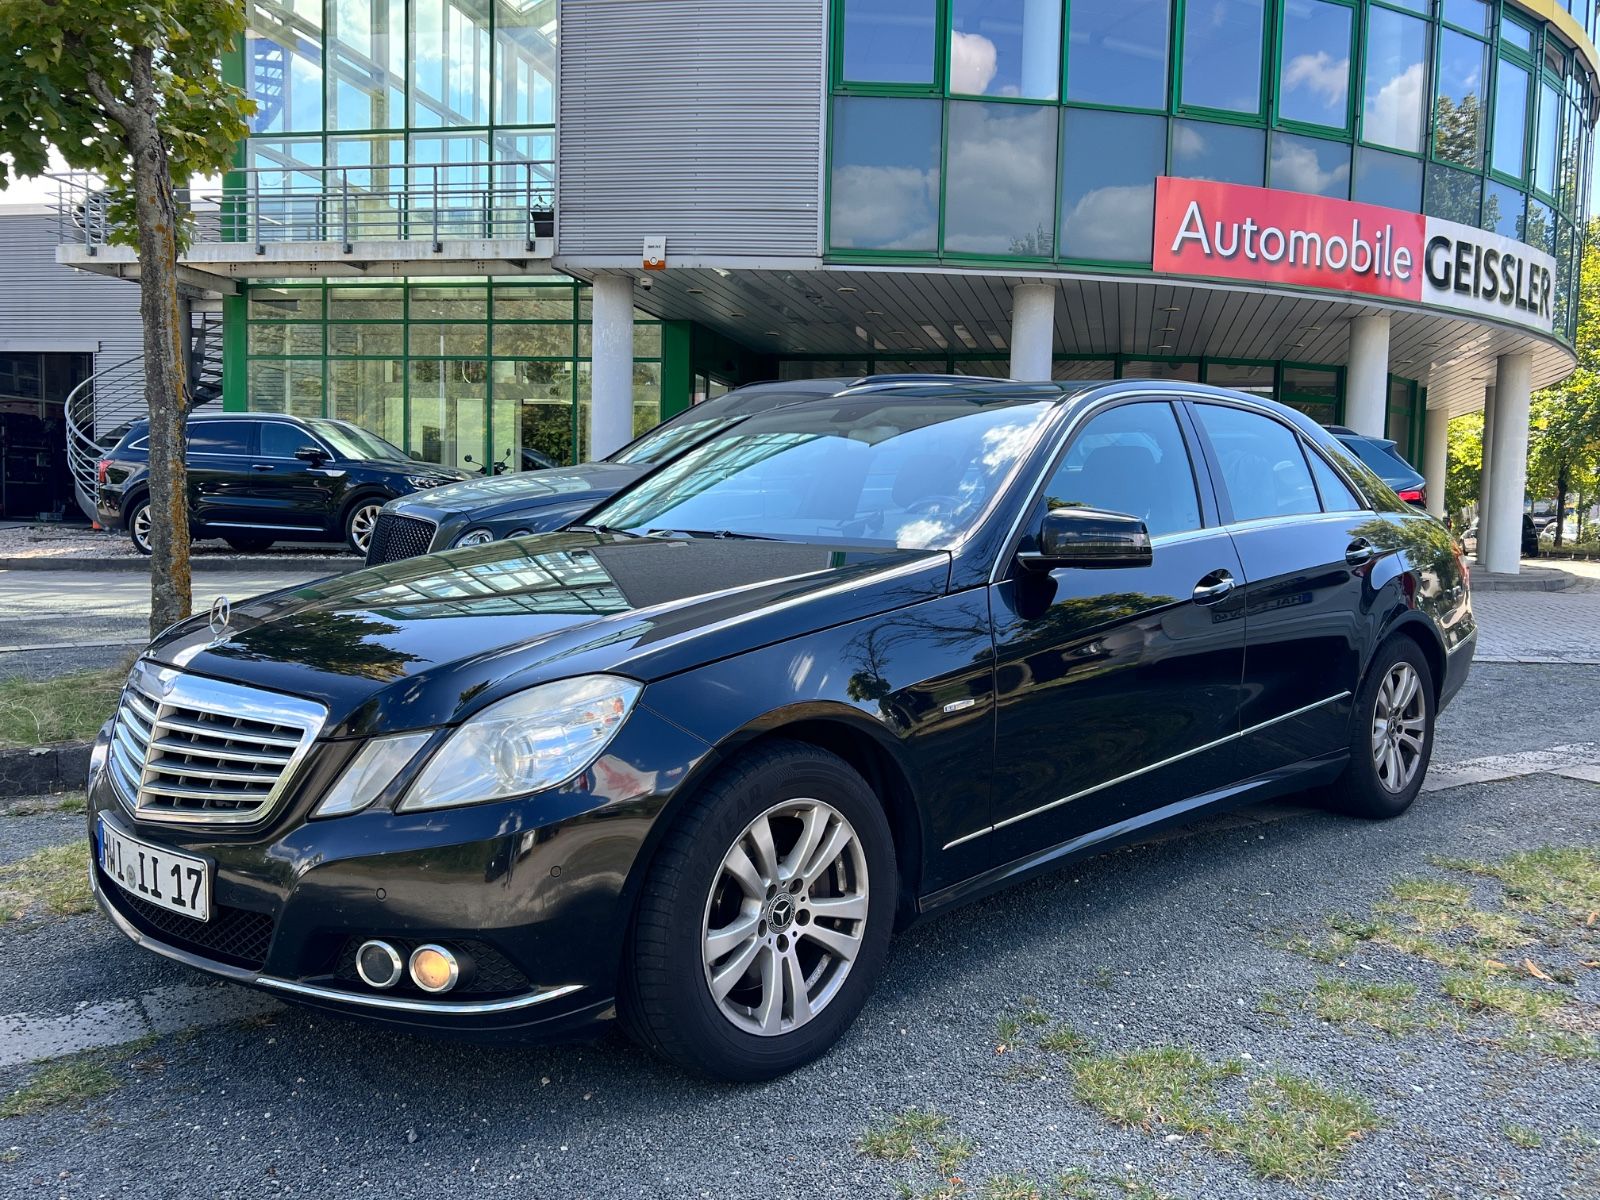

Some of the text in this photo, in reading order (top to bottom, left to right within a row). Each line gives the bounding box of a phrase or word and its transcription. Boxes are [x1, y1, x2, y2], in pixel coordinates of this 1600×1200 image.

[1171, 200, 1552, 320] Automobile GEISSLER
[138, 851, 162, 899] II
[170, 863, 203, 910] 17
